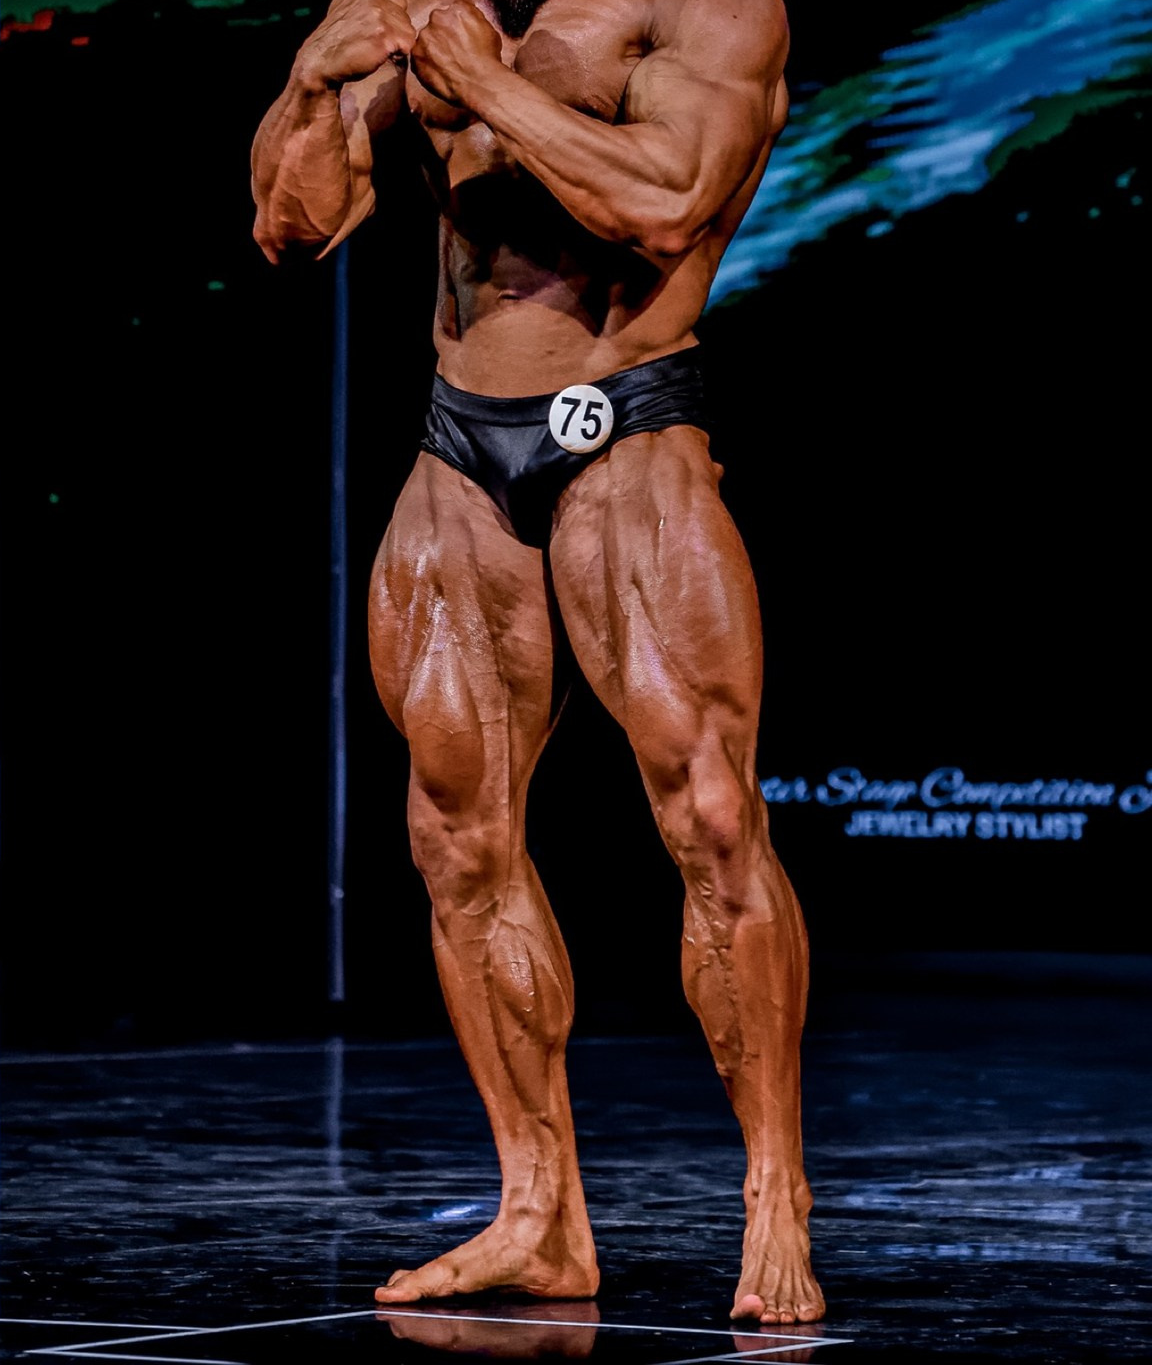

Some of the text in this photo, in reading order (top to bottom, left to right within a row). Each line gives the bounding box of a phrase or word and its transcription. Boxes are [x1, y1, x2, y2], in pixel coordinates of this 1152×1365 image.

[559, 396, 605, 441] 75
[845, 810, 1089, 840] JEWELRY STYLIST
